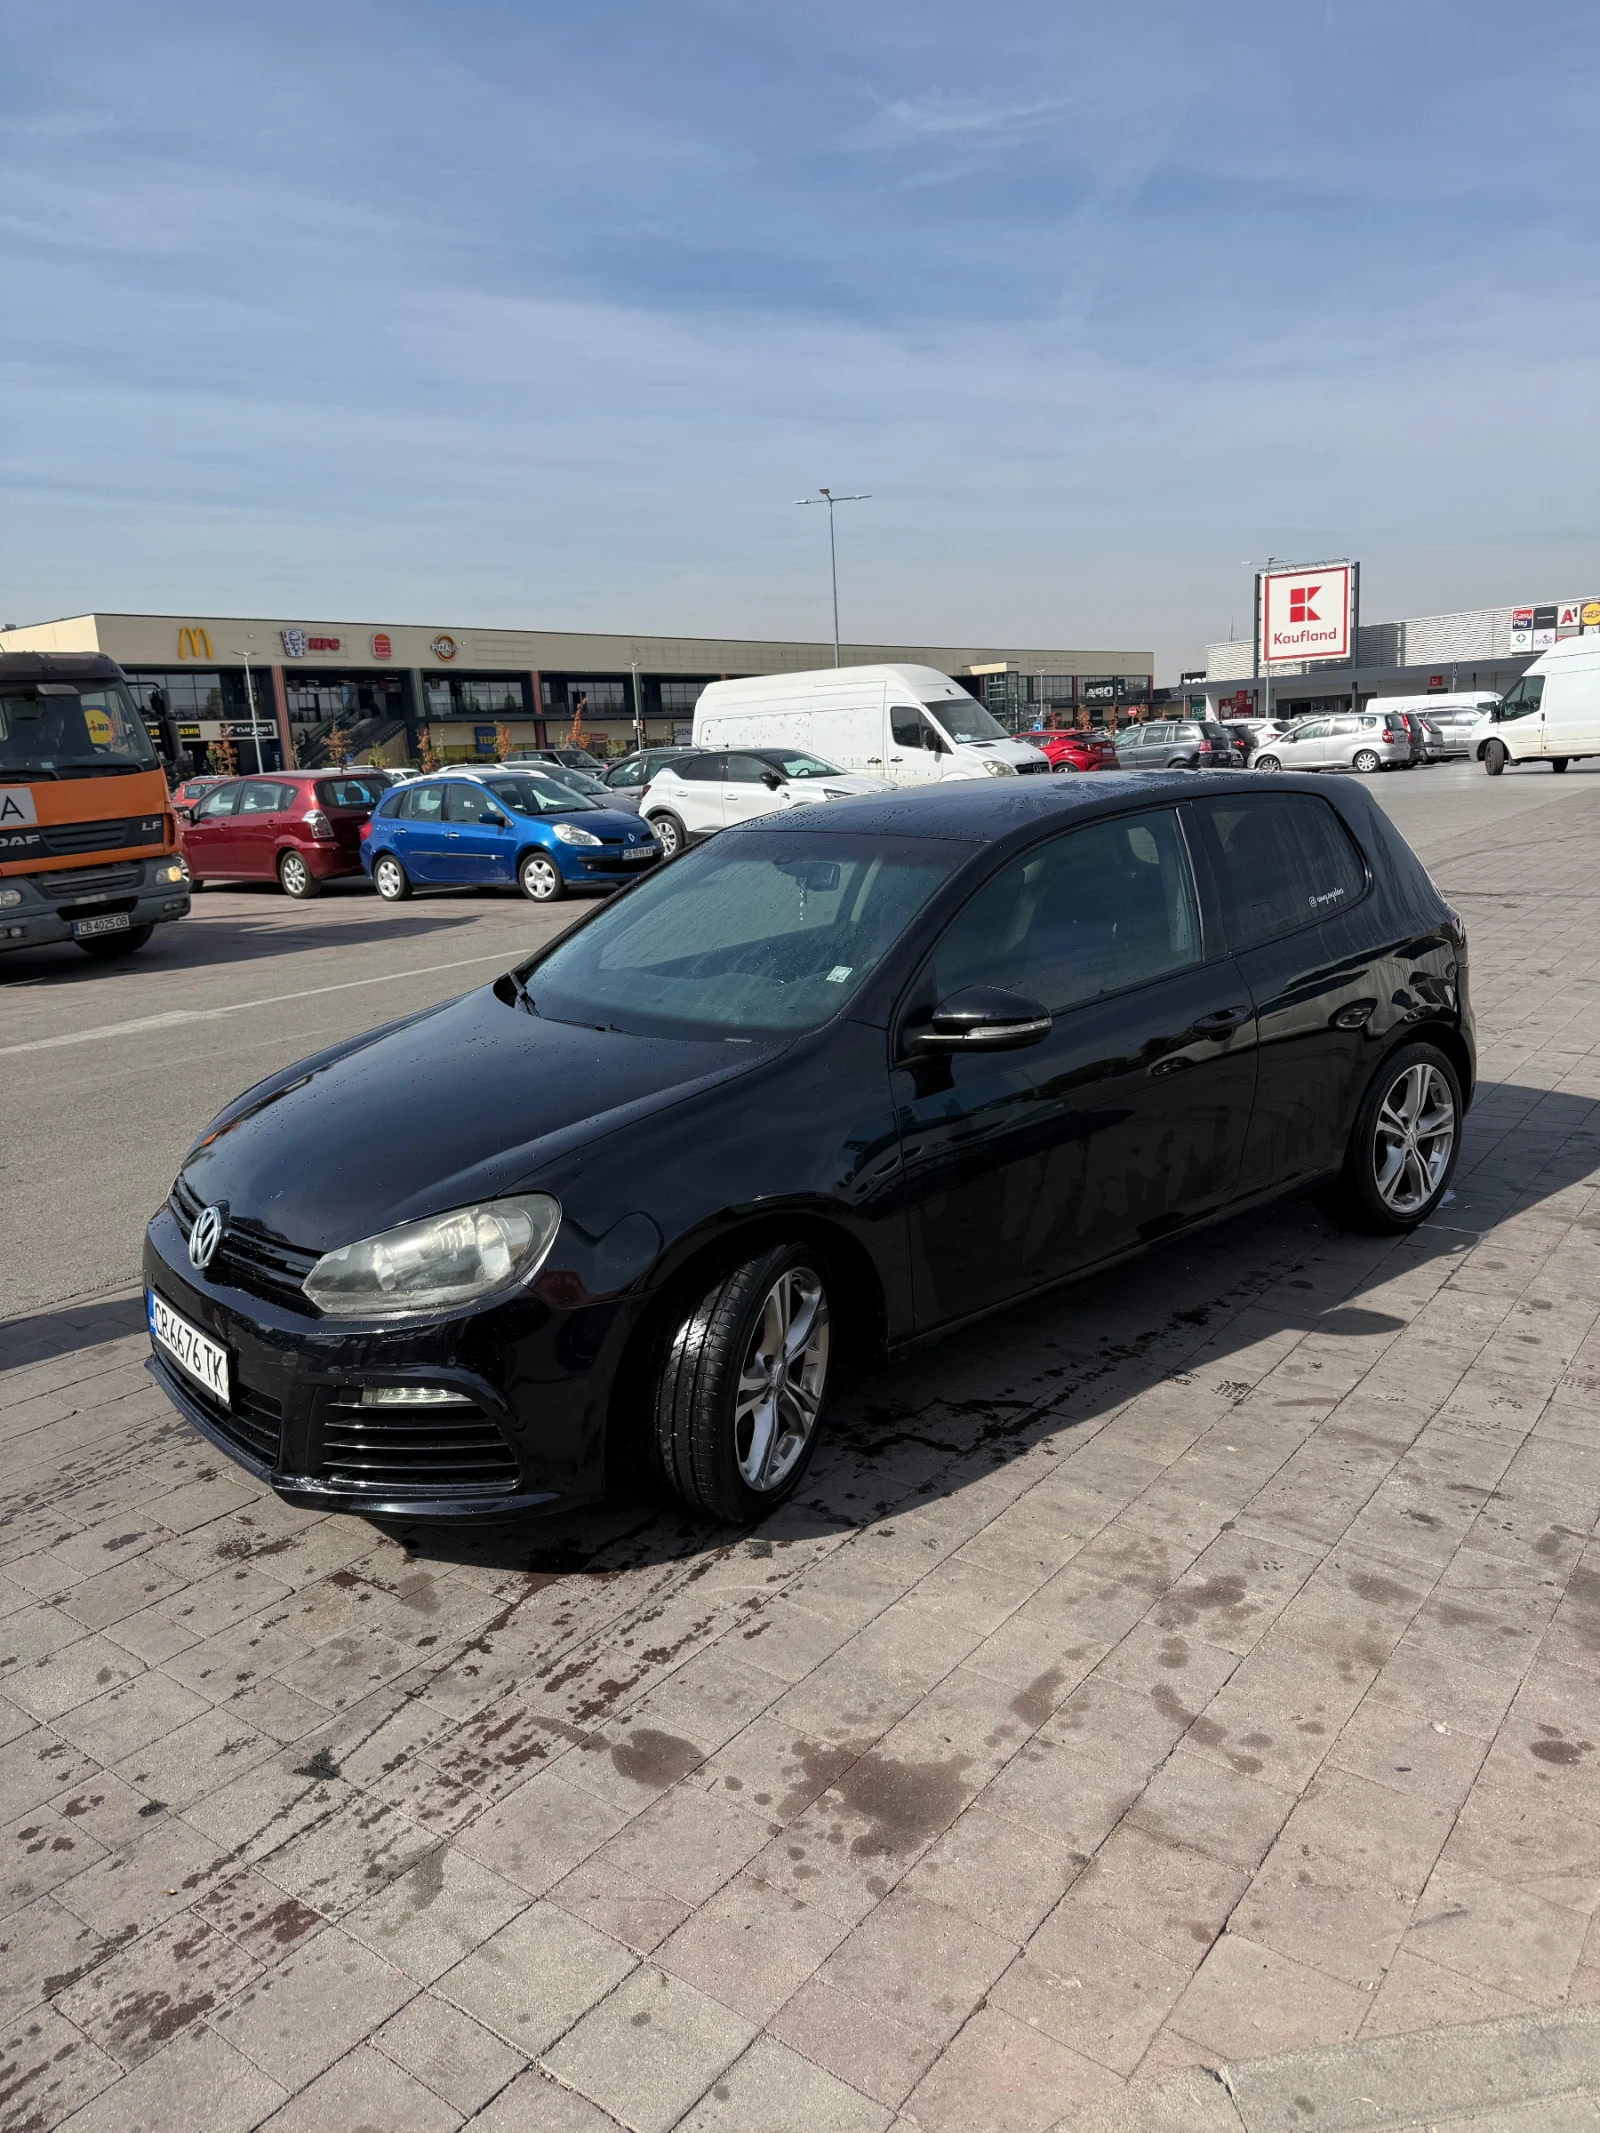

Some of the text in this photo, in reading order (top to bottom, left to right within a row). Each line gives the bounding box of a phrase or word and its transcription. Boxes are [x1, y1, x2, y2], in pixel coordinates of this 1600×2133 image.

[1513, 612, 1532, 620] Easy
[1560, 607, 1578, 625] A1
[1273, 627, 1337, 645] Kaufland
[309, 638, 340, 651] KFC
[1, 795, 25, 821] A
[142, 821, 162, 831] LF
[94, 919, 115, 930] 4025
[155, 1302, 224, 1392] CB 6676 TK
